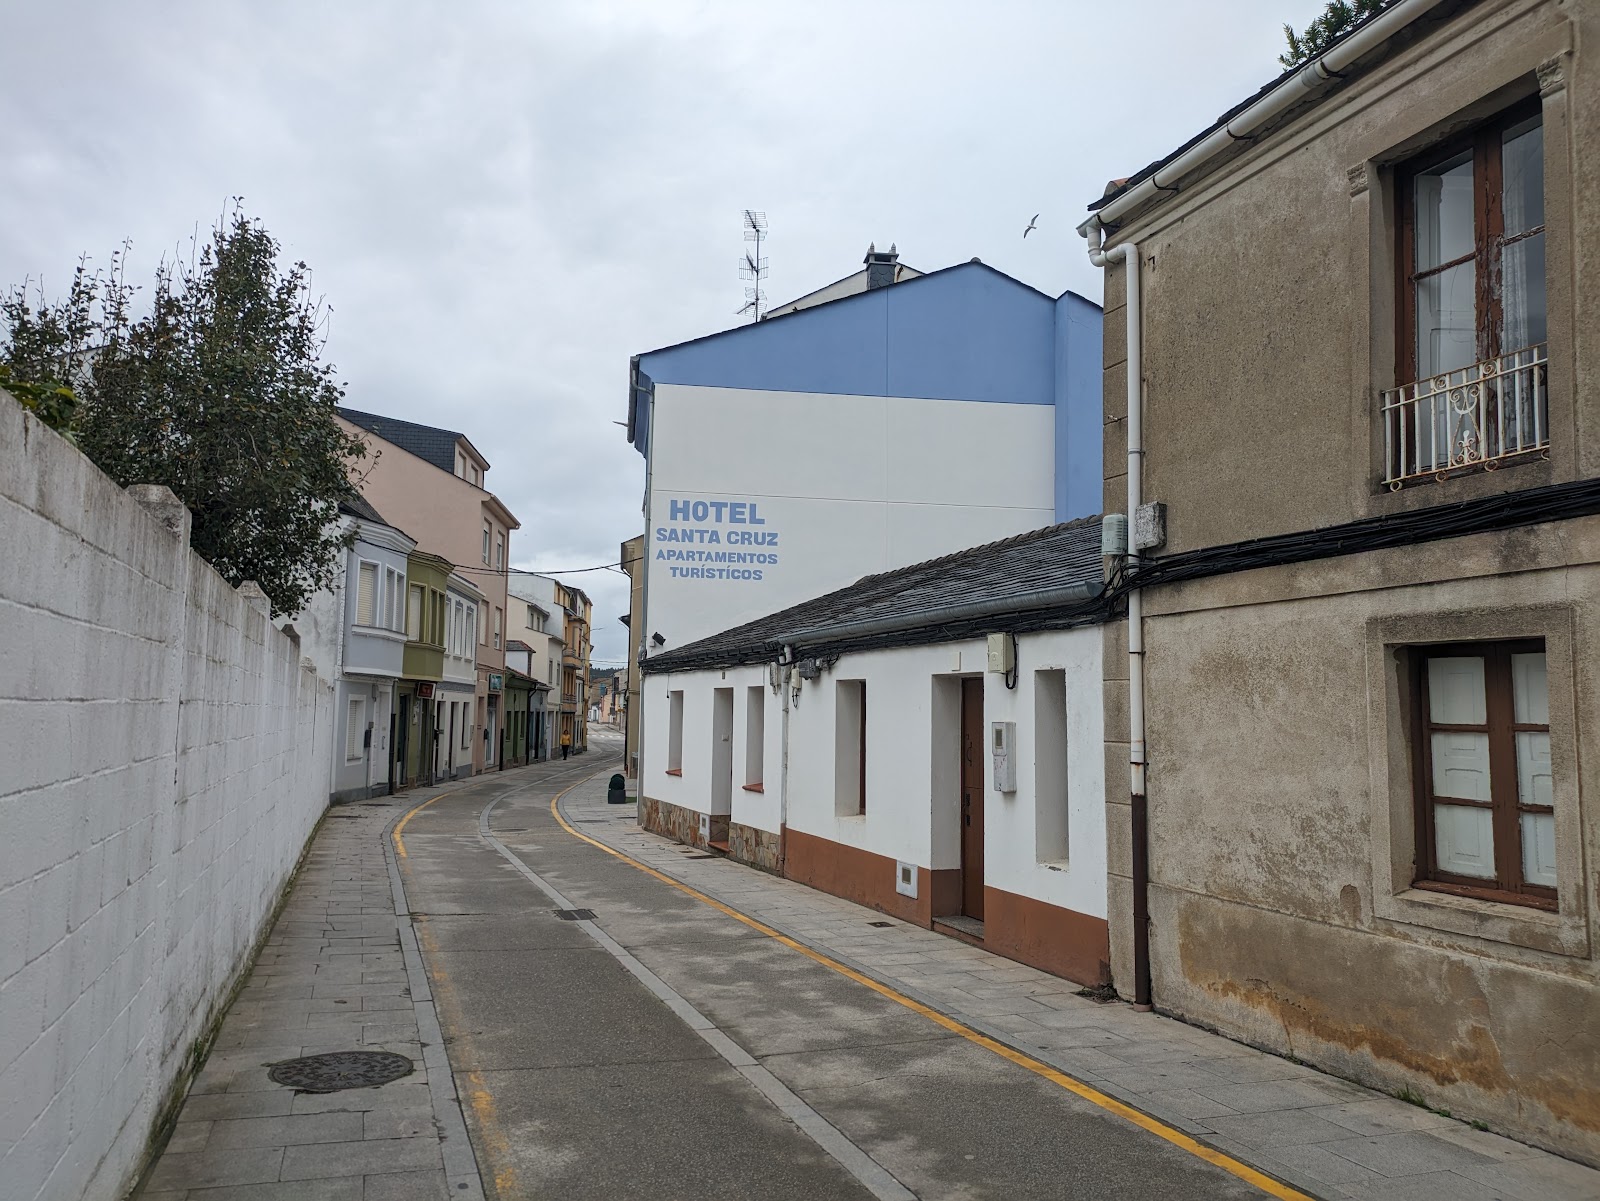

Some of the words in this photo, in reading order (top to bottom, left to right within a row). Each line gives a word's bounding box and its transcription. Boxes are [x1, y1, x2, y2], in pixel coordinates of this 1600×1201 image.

[669, 499, 765, 525] HOTEL
[656, 527, 721, 544] SANTA
[726, 531, 778, 546] CRUZ
[656, 549, 778, 564] APARTAMENTOS
